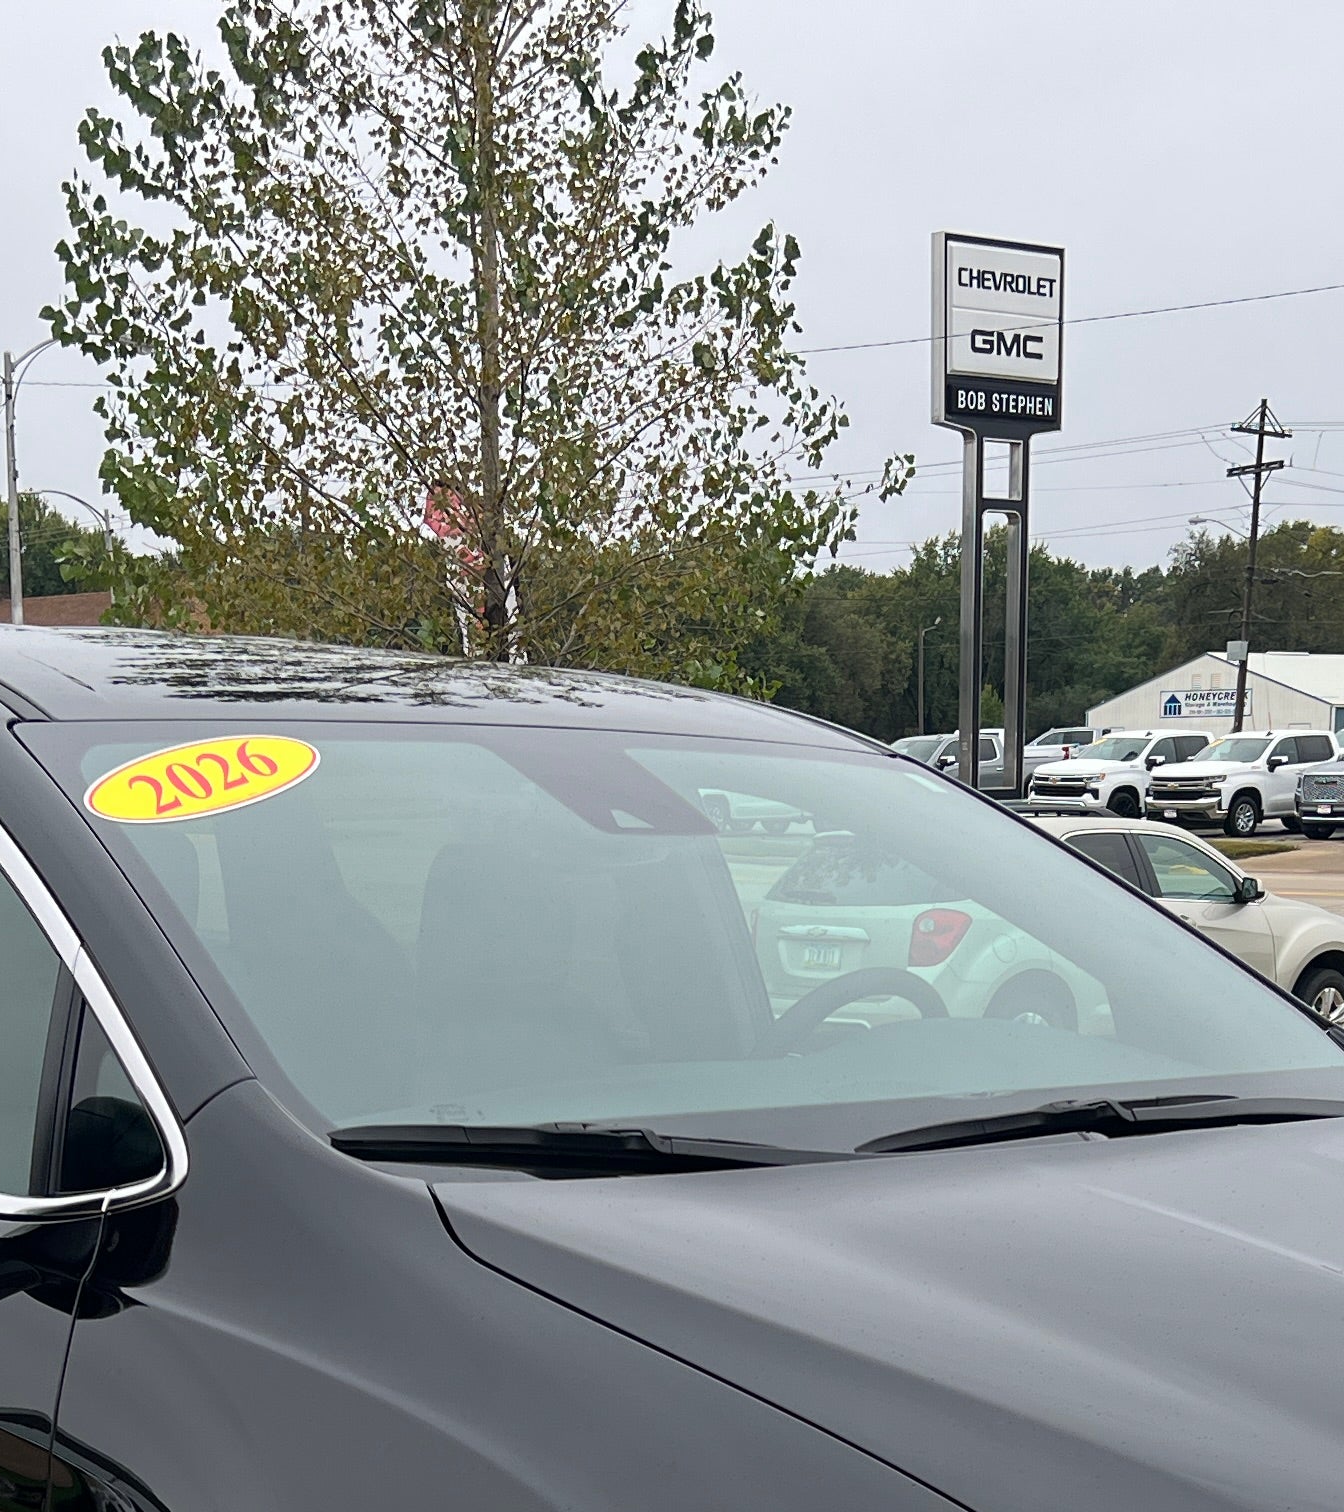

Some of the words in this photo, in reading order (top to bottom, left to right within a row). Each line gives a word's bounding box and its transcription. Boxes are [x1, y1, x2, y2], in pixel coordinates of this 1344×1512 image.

[958, 267, 1056, 298] CHEVROLET
[970, 328, 1043, 360] GMC
[957, 389, 986, 411] BOB
[991, 393, 1053, 416] STEPHEN
[1184, 691, 1249, 701] HONEYCREK
[128, 740, 278, 815] 2026
